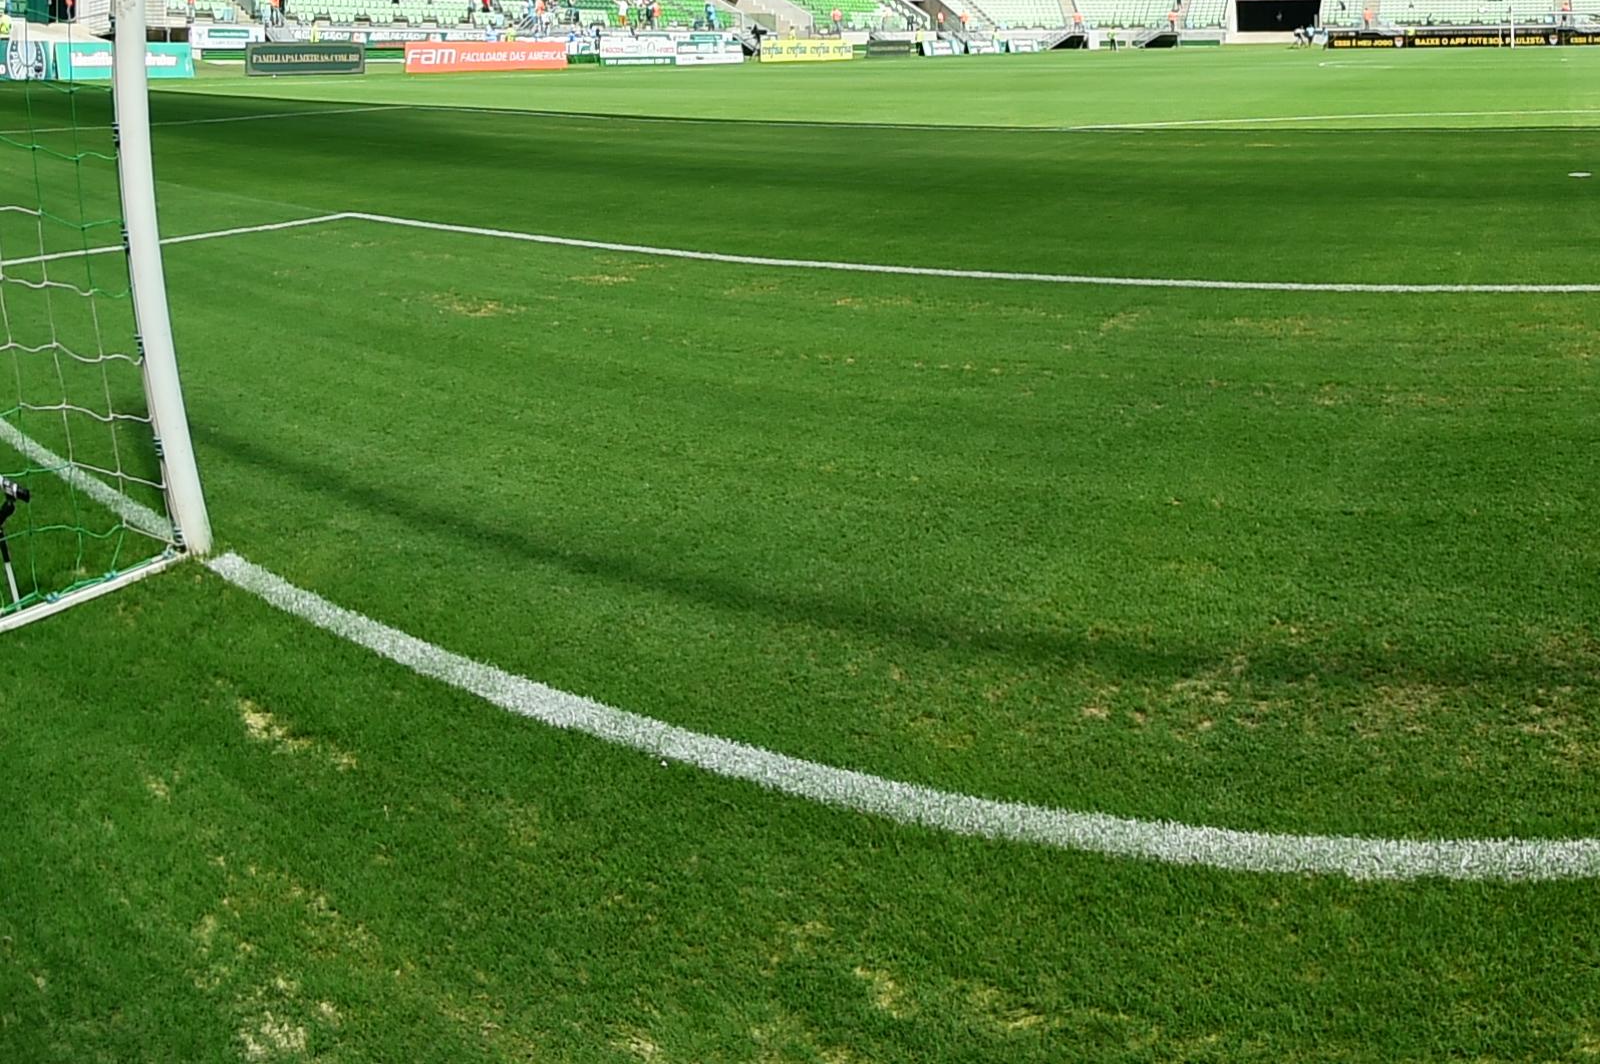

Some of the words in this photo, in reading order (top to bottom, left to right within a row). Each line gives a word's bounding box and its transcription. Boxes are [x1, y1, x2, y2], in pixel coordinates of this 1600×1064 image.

[1414, 38, 1440, 46] BAIXE
[1450, 37, 1467, 45] APP
[459, 51, 507, 63] FACULDADE
[509, 51, 526, 61] DAS
